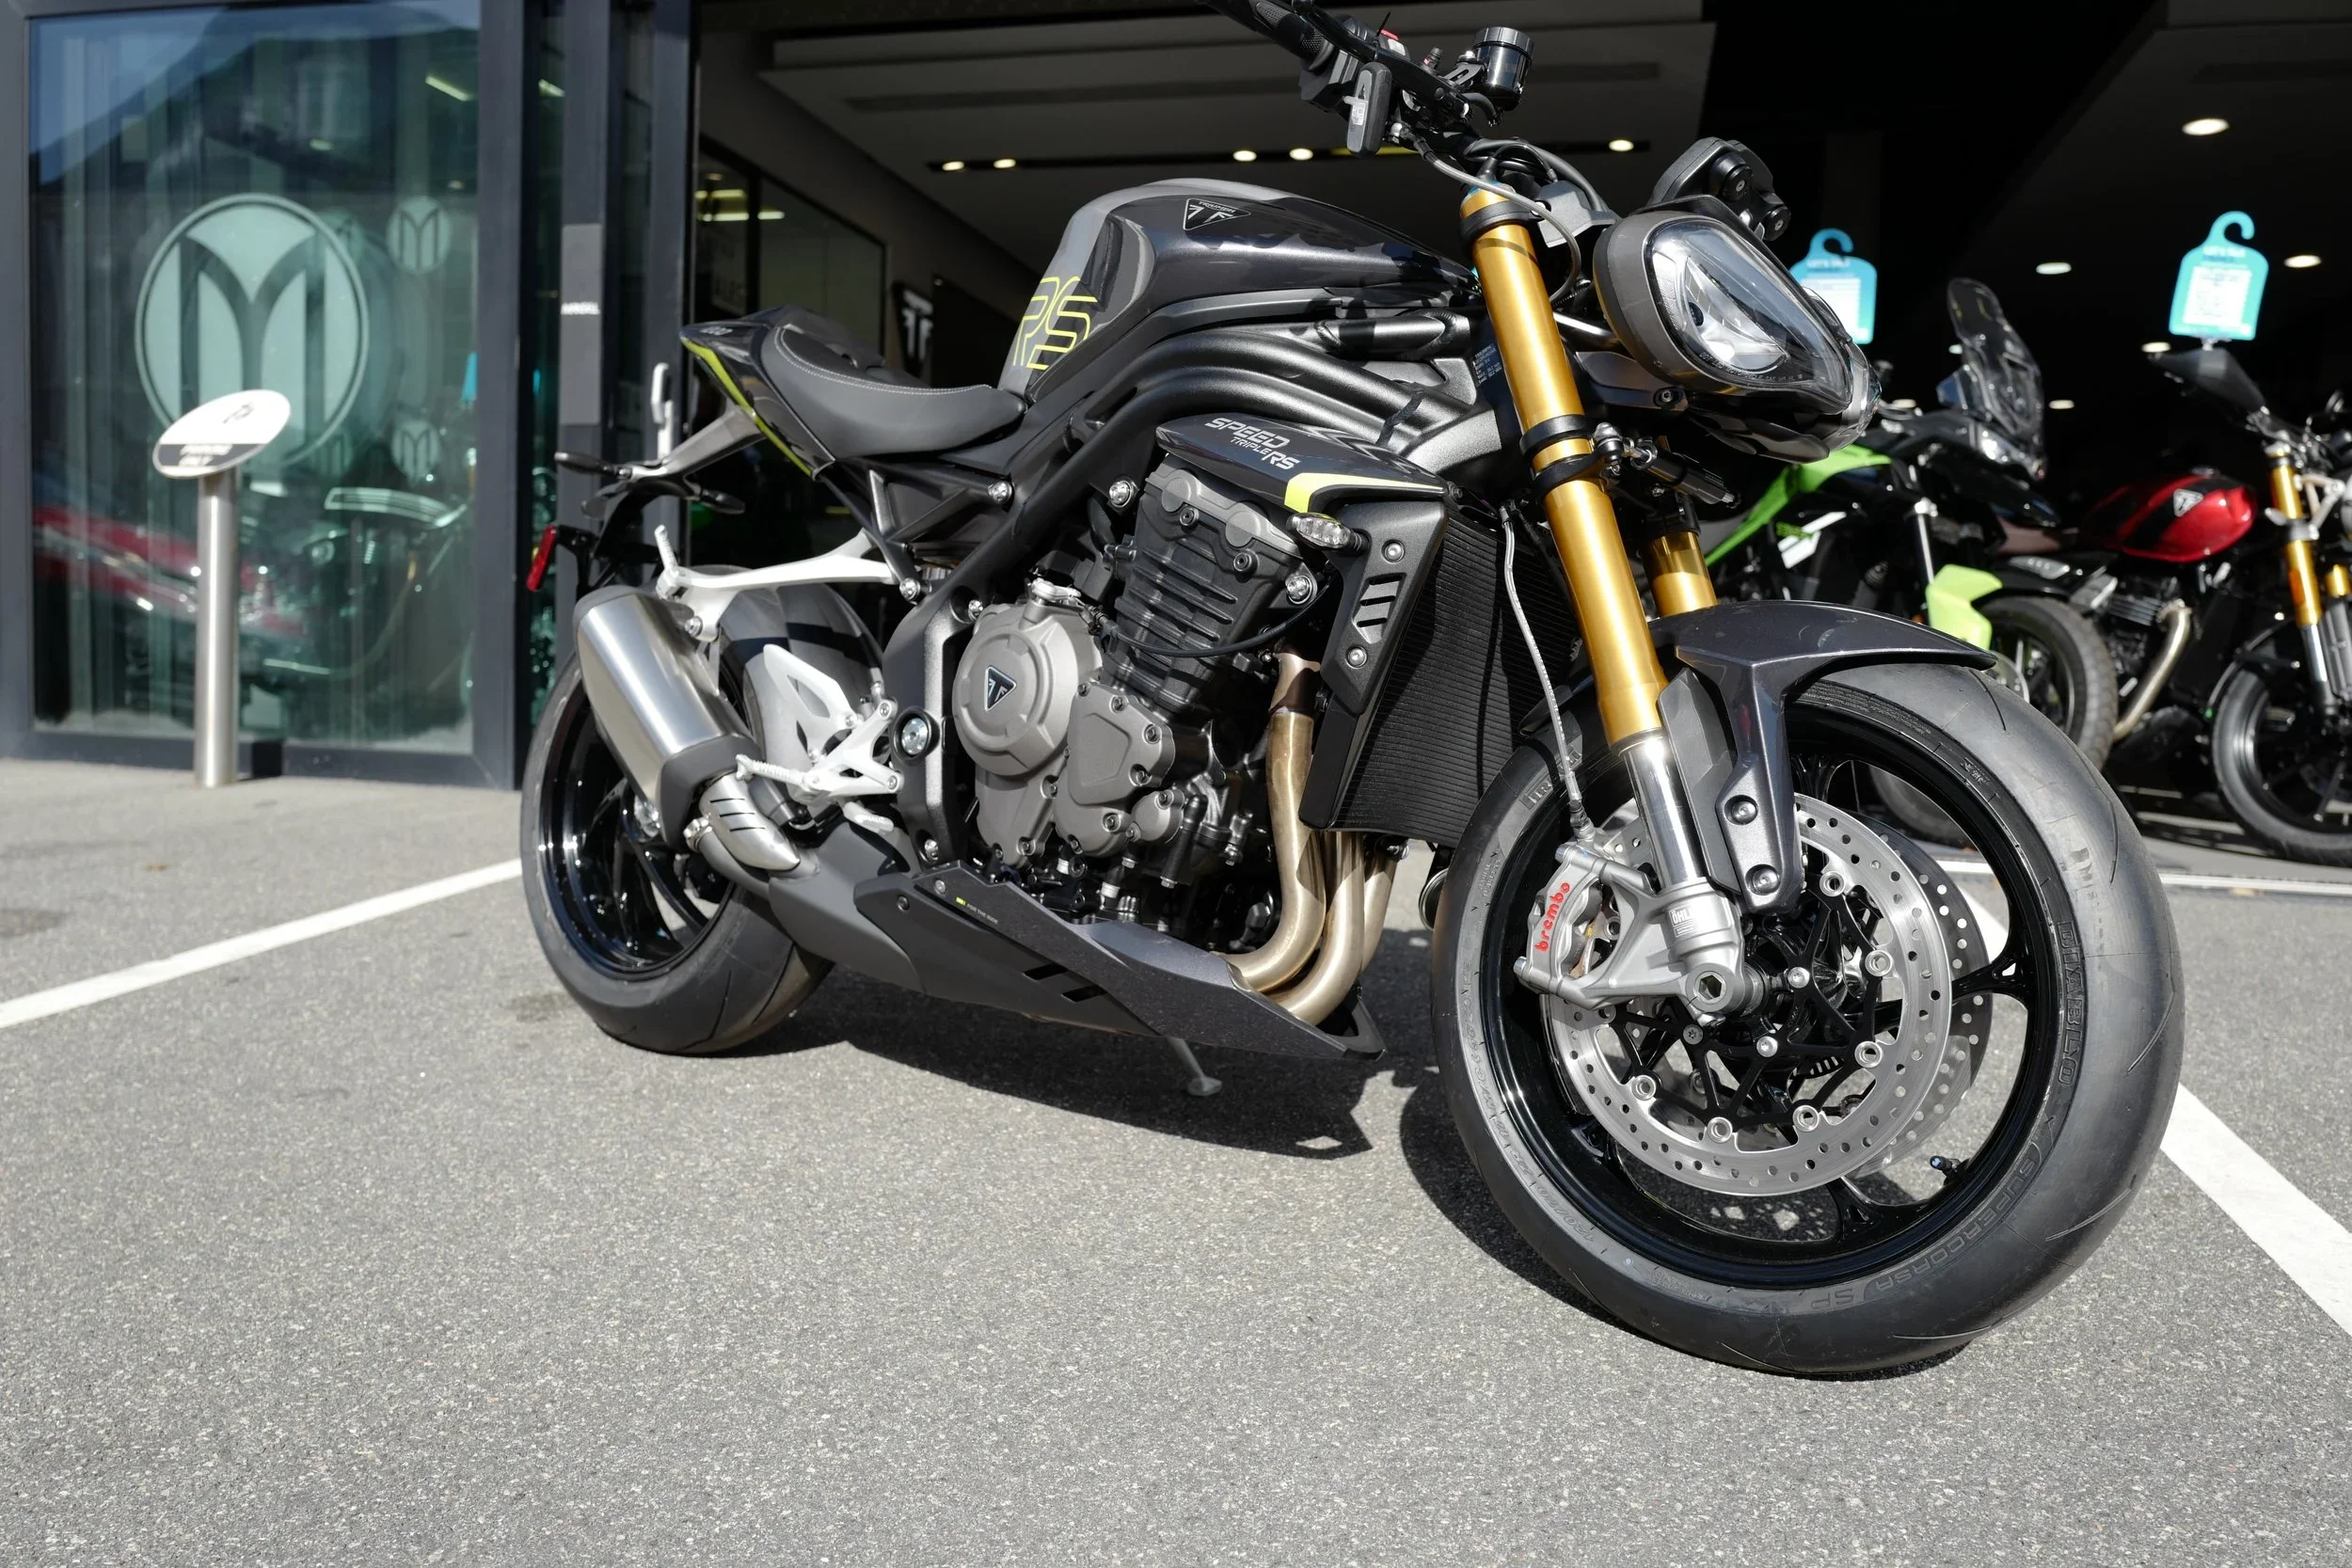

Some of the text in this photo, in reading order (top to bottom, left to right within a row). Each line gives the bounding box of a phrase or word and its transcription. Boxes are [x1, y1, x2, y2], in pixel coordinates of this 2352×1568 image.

[1204, 418, 1291, 449] SPEED
[1230, 436, 1301, 470] TRIPLE RS
[1534, 882, 1570, 952] brembo
[2056, 921, 2083, 1085] DIABLO
[1810, 1156, 2036, 1309] SUPERCORSA SP
